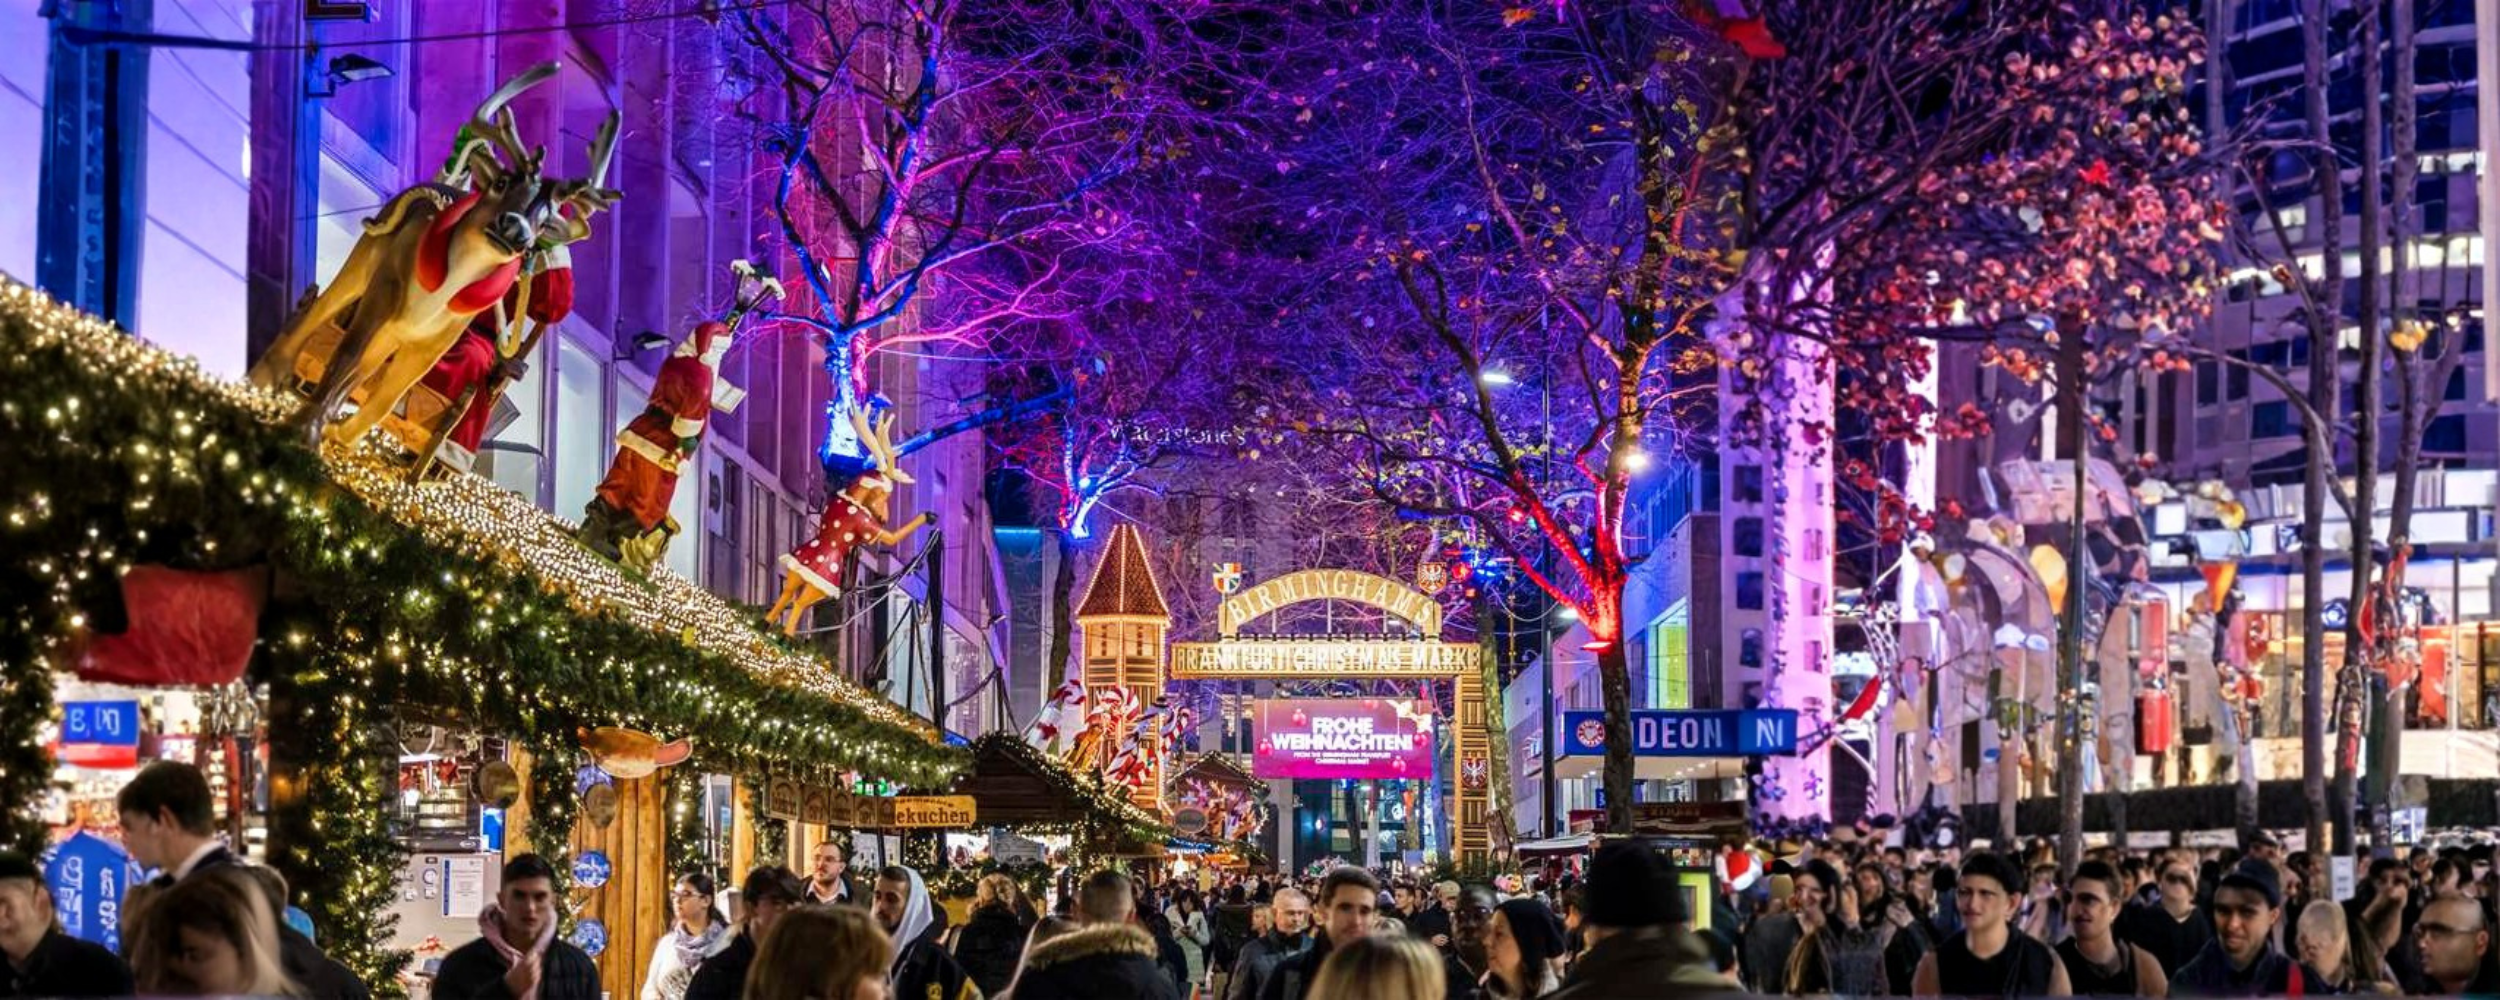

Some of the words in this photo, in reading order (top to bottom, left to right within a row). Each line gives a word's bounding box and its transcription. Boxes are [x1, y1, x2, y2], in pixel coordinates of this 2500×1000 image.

[1227, 571, 1432, 624] BIRMINGHAM'S
[1312, 717, 1374, 734] FROHE
[1631, 717, 1723, 749] DEON
[1271, 733, 1414, 751] WEIHNACHTEN!
[897, 807, 971, 824] ekuchen
